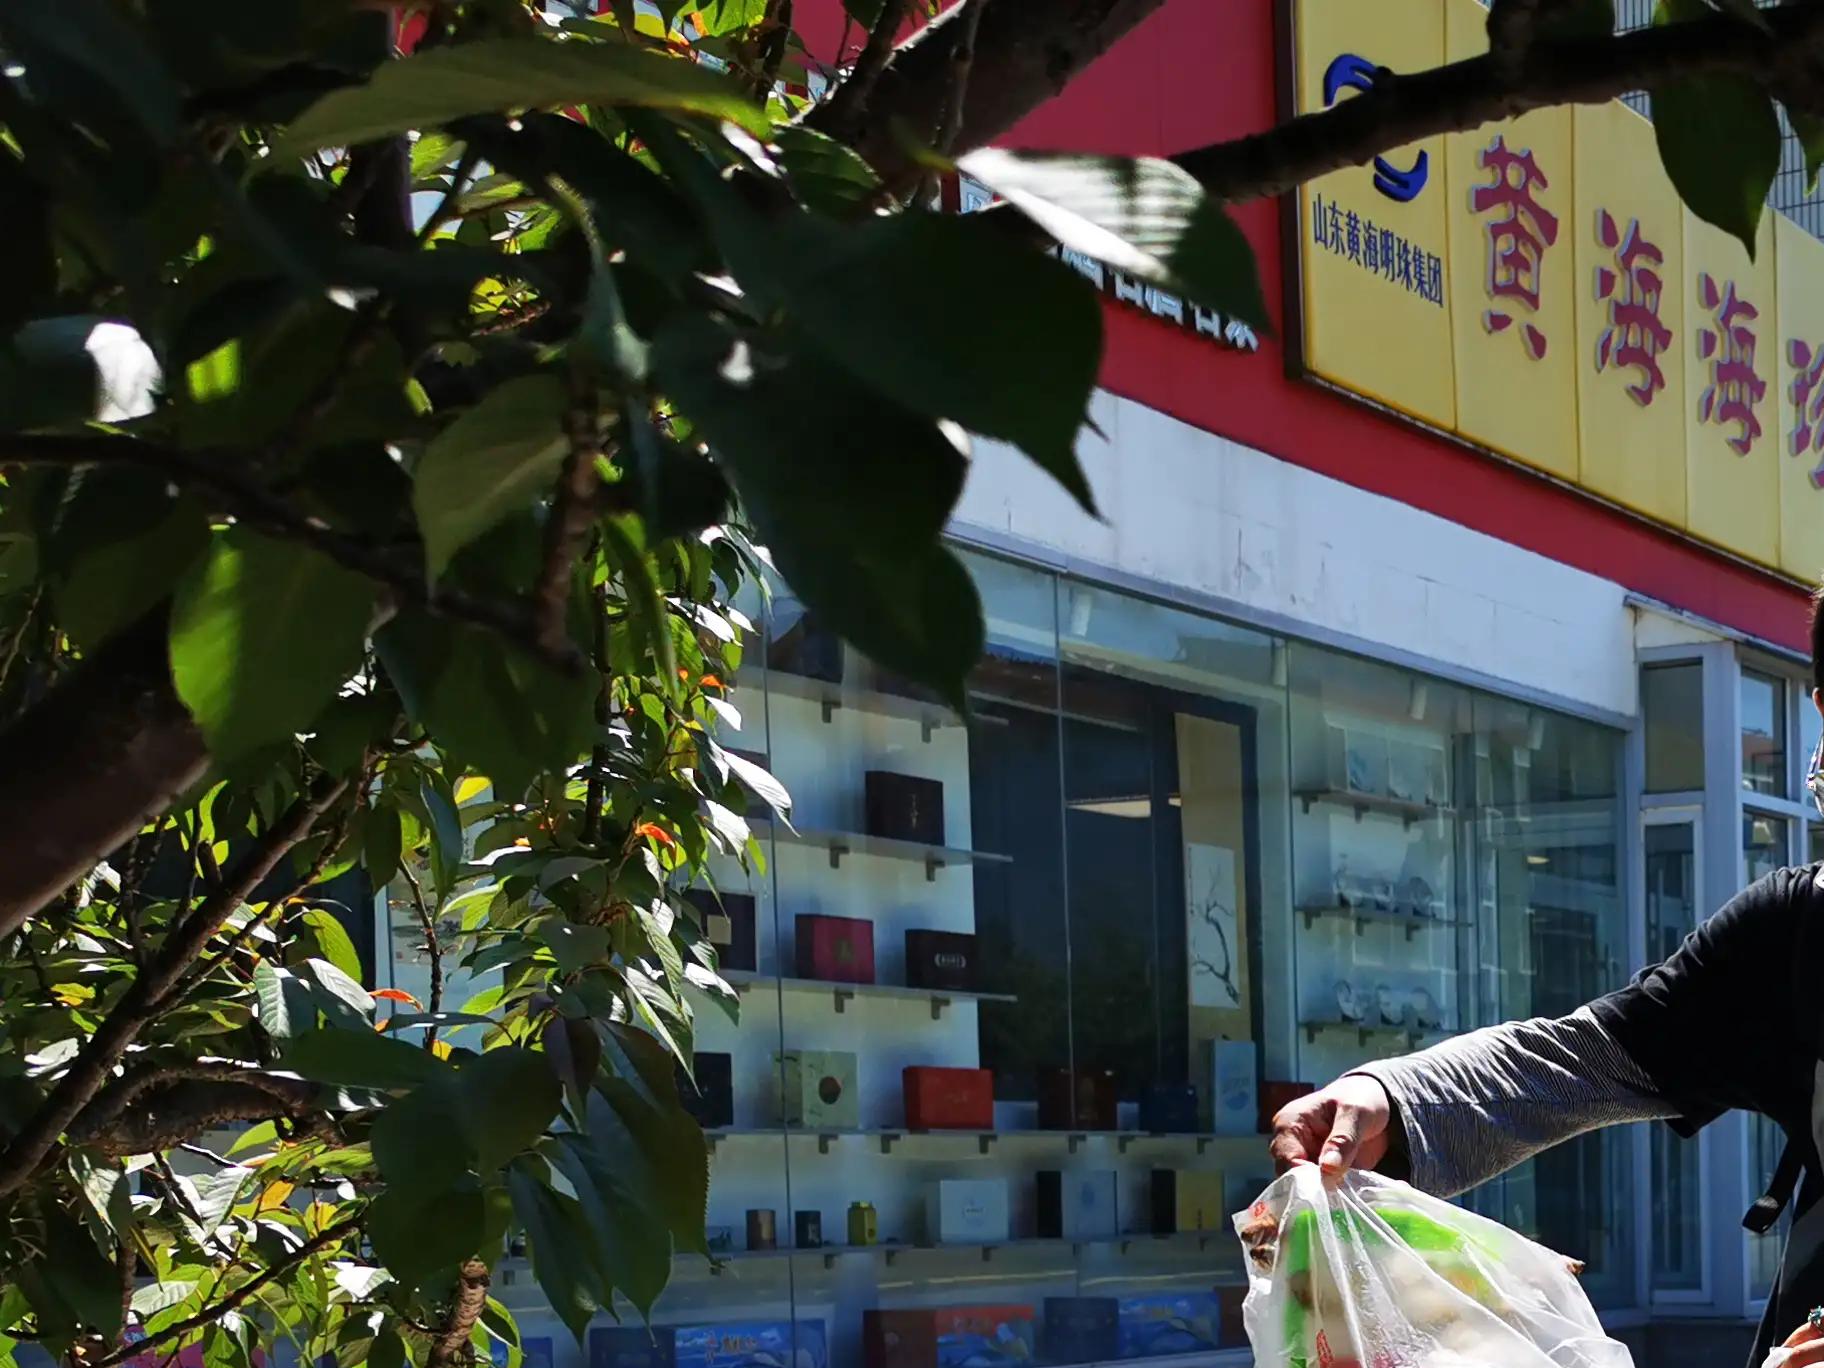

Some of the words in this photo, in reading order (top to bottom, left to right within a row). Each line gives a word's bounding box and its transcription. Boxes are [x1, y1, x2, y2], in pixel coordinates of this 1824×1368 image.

[1312, 192, 1444, 308] 山东黄海明珠集团
